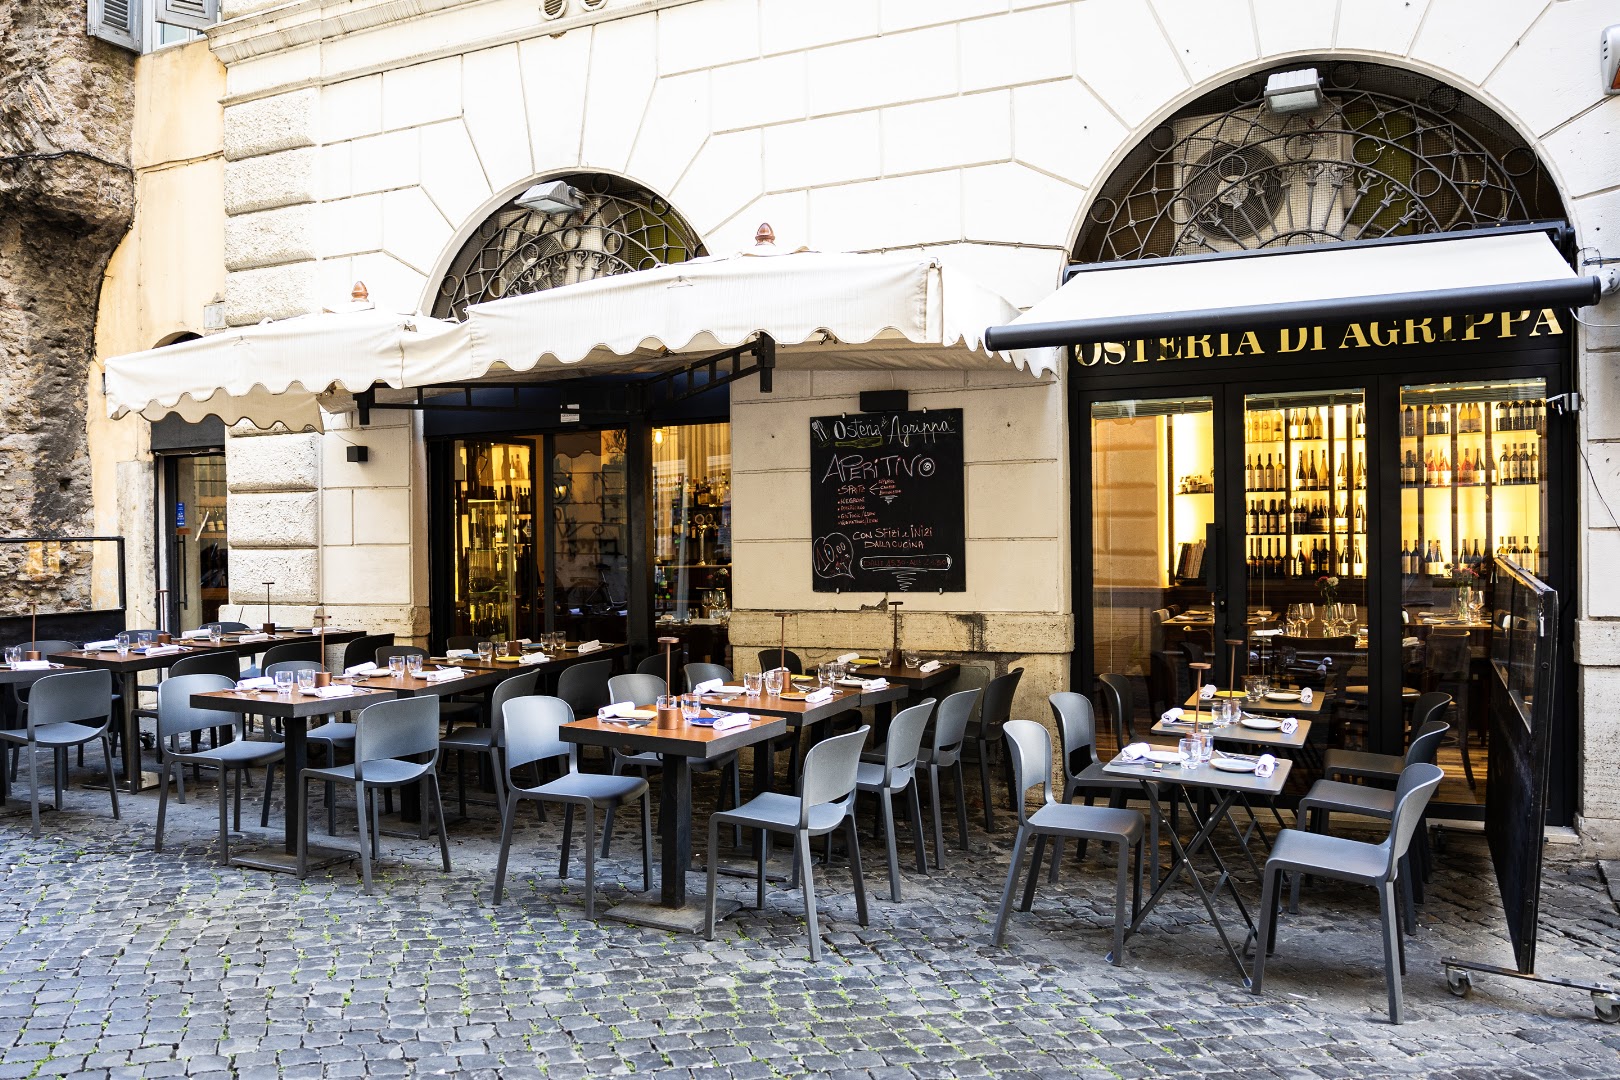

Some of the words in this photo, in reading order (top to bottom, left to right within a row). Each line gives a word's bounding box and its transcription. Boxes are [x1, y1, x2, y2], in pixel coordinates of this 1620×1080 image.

[1074, 331, 1265, 367] OSTERIA
[1277, 326, 1327, 353] DI
[1338, 308, 1564, 348] AGRIPPA
[833, 418, 883, 440] Osteria
[888, 415, 955, 448] Agrippa
[852, 531, 873, 541] CON
[864, 540, 891, 549] DALLA
